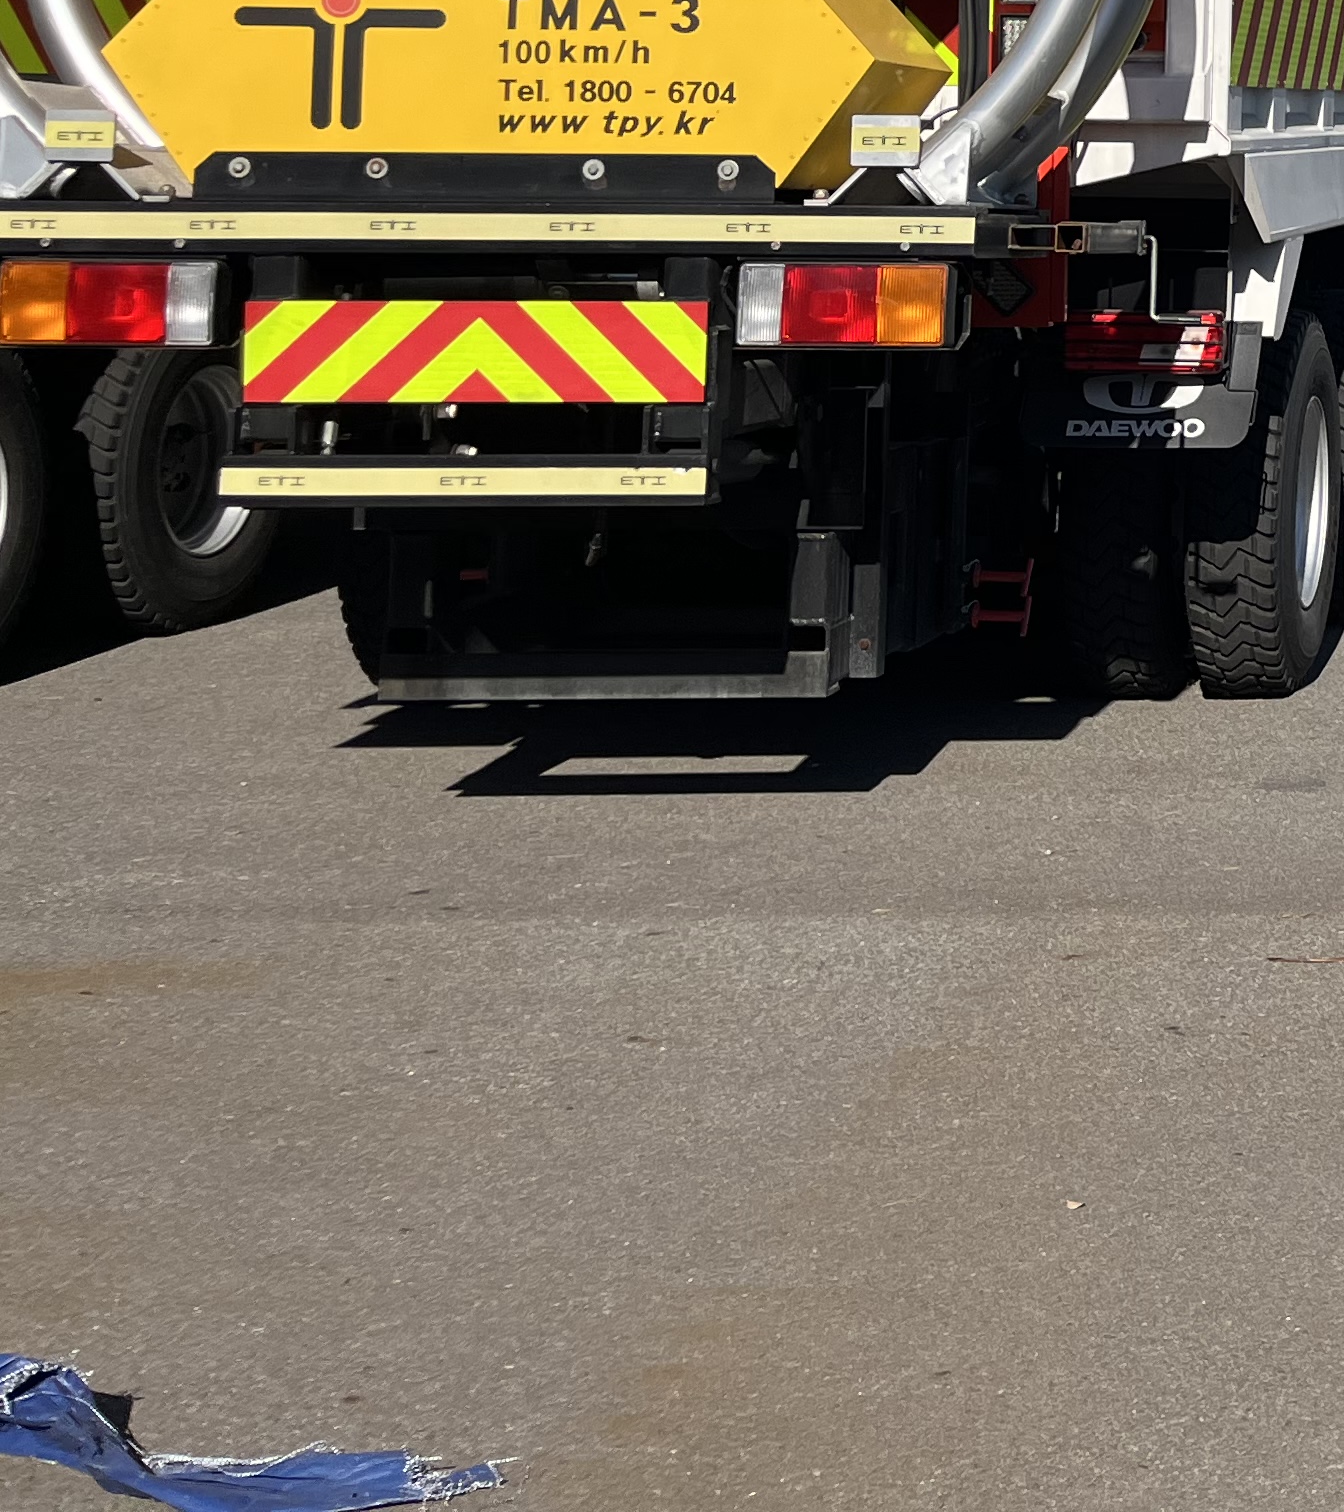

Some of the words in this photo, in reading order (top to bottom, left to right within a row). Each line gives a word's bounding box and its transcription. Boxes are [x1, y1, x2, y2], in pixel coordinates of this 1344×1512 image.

[498, 79, 550, 103] Tel.
[564, 80, 633, 103] 1800
[668, 81, 737, 104] 6704
[1065, 418, 1205, 439] DAEWOO
